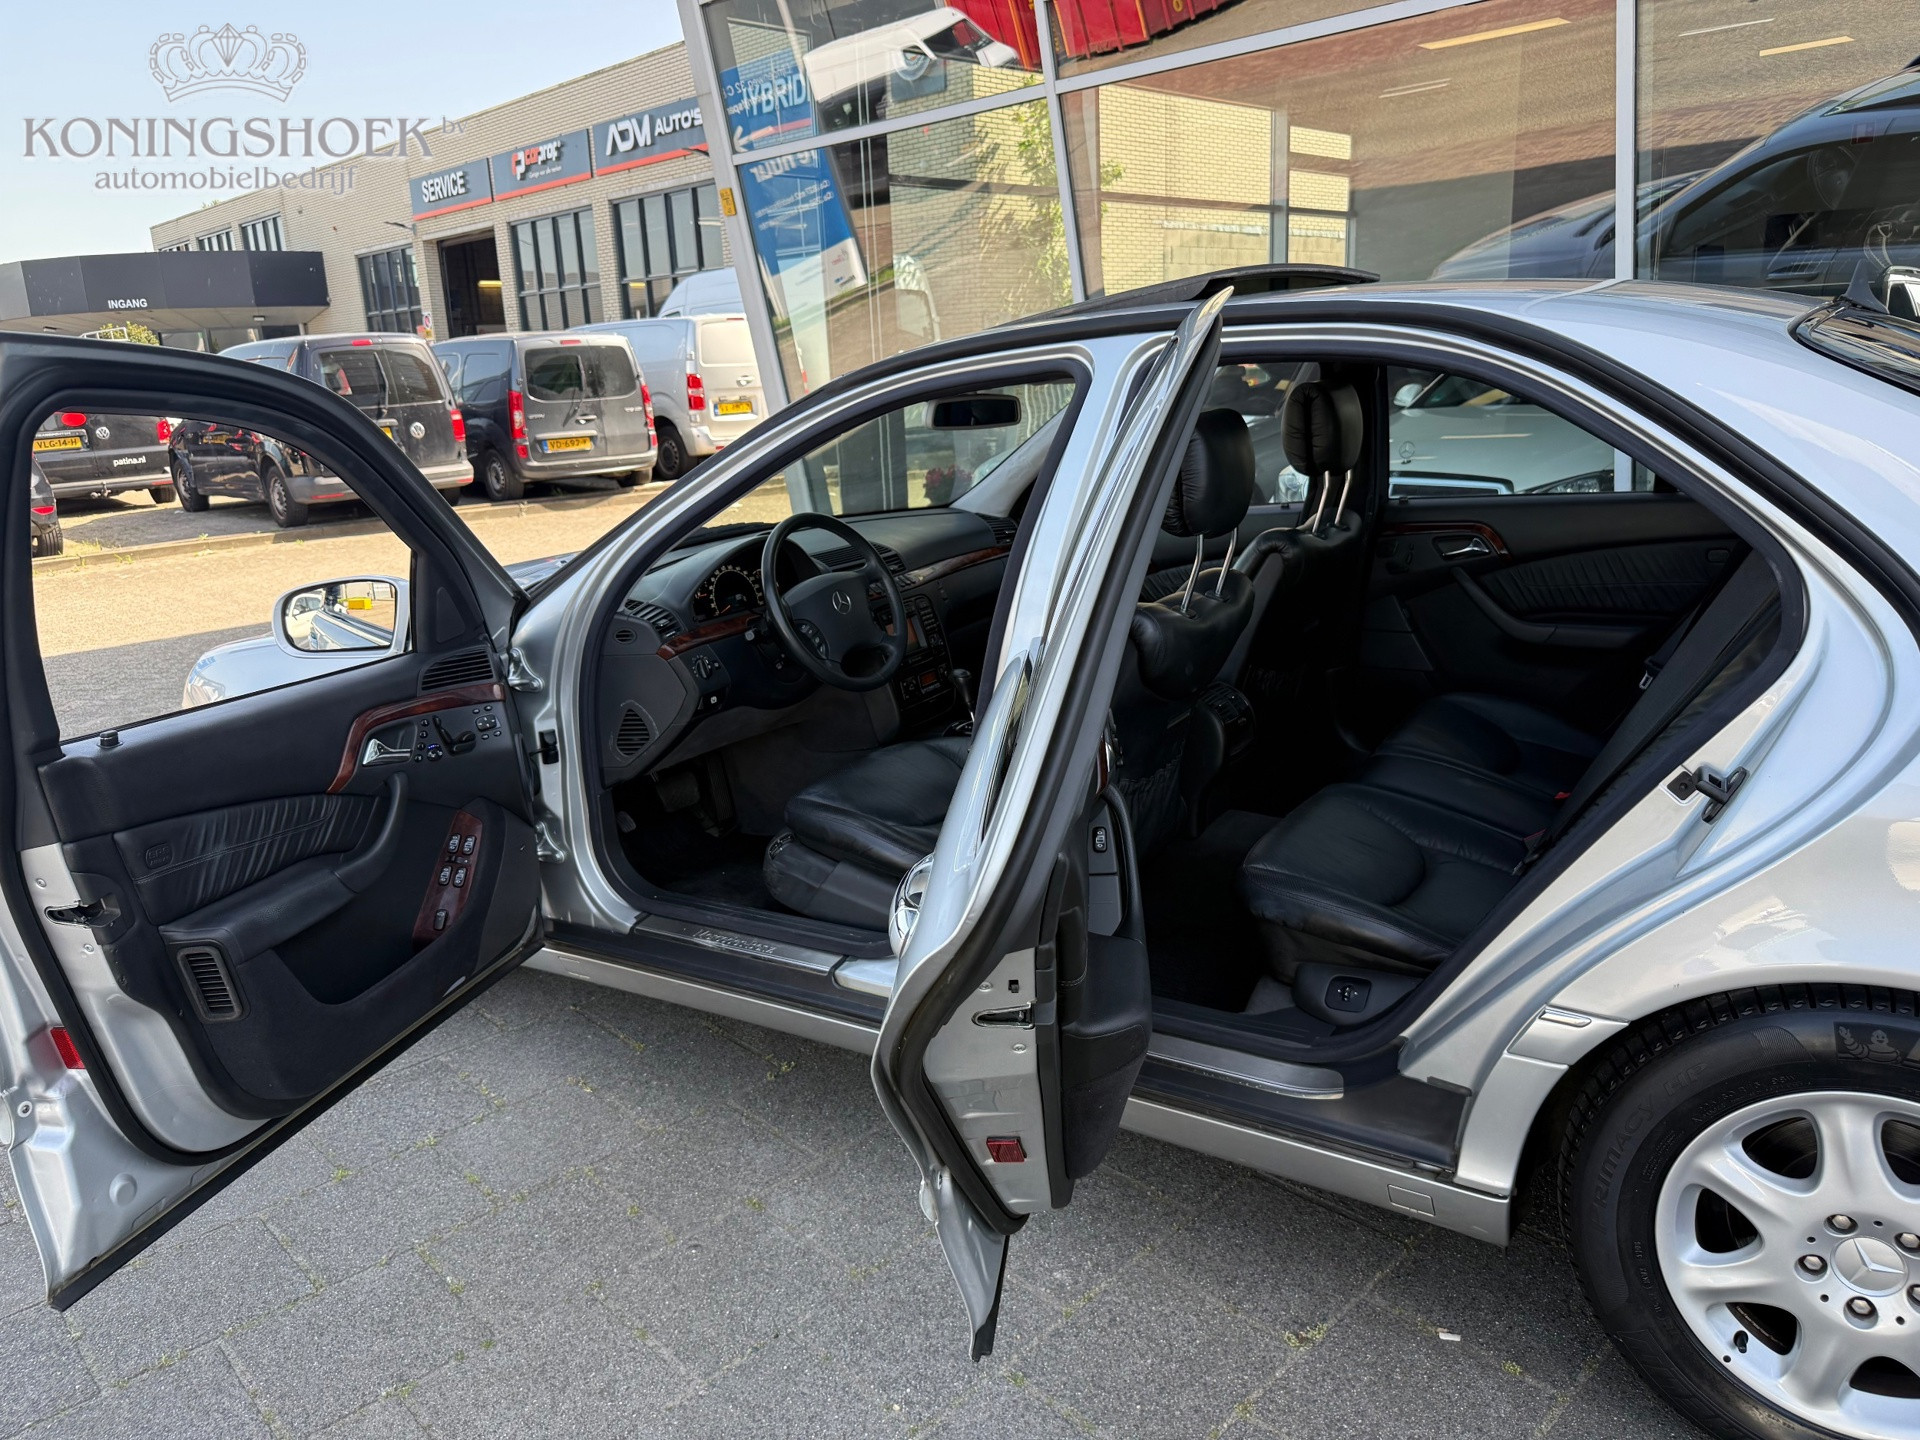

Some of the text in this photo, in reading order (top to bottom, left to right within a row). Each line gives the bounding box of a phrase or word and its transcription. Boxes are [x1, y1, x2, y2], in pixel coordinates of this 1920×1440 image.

[654, 107, 703, 137] AUTO'S
[421, 171, 466, 203] SERVICE
[108, 298, 148, 309] INGANG
[37, 439, 77, 449] VLG-14-H
[113, 456, 147, 468] patina.nl
